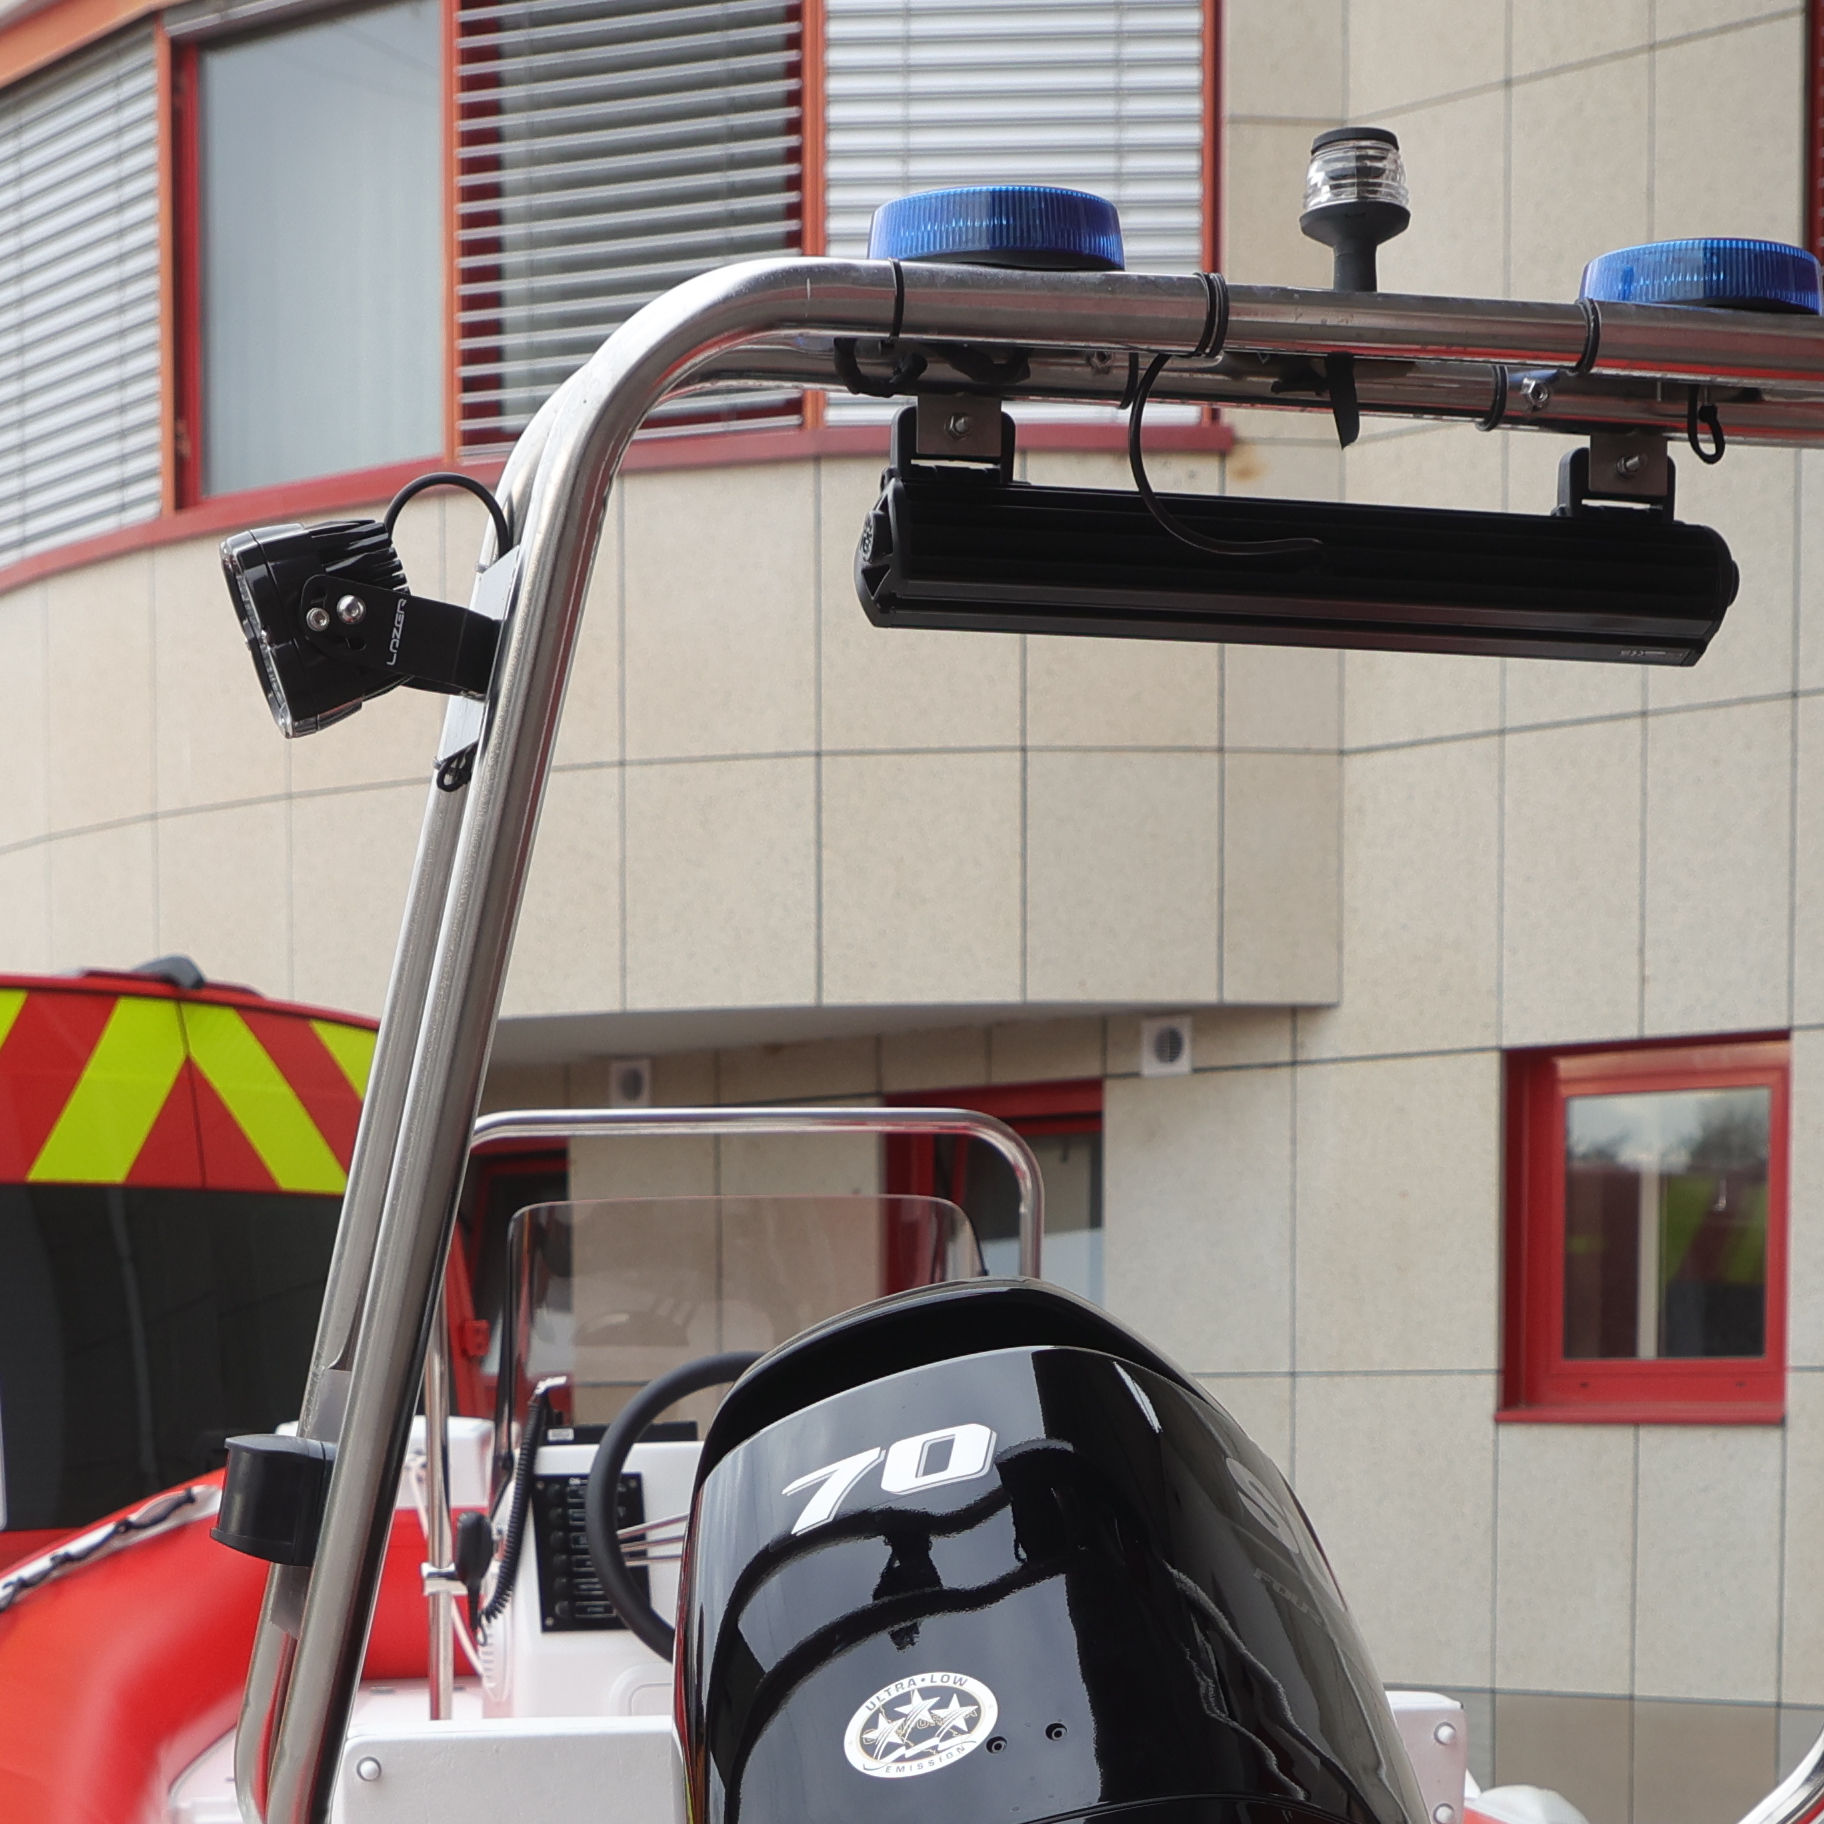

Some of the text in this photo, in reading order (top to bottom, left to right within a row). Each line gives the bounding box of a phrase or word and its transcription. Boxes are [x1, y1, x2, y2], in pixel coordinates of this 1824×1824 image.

[386, 598, 407, 666] LAZER
[782, 1423, 997, 1536] 70
[865, 1674, 969, 1712] ULTRA LOW
[885, 1745, 966, 1773] EMISSION
